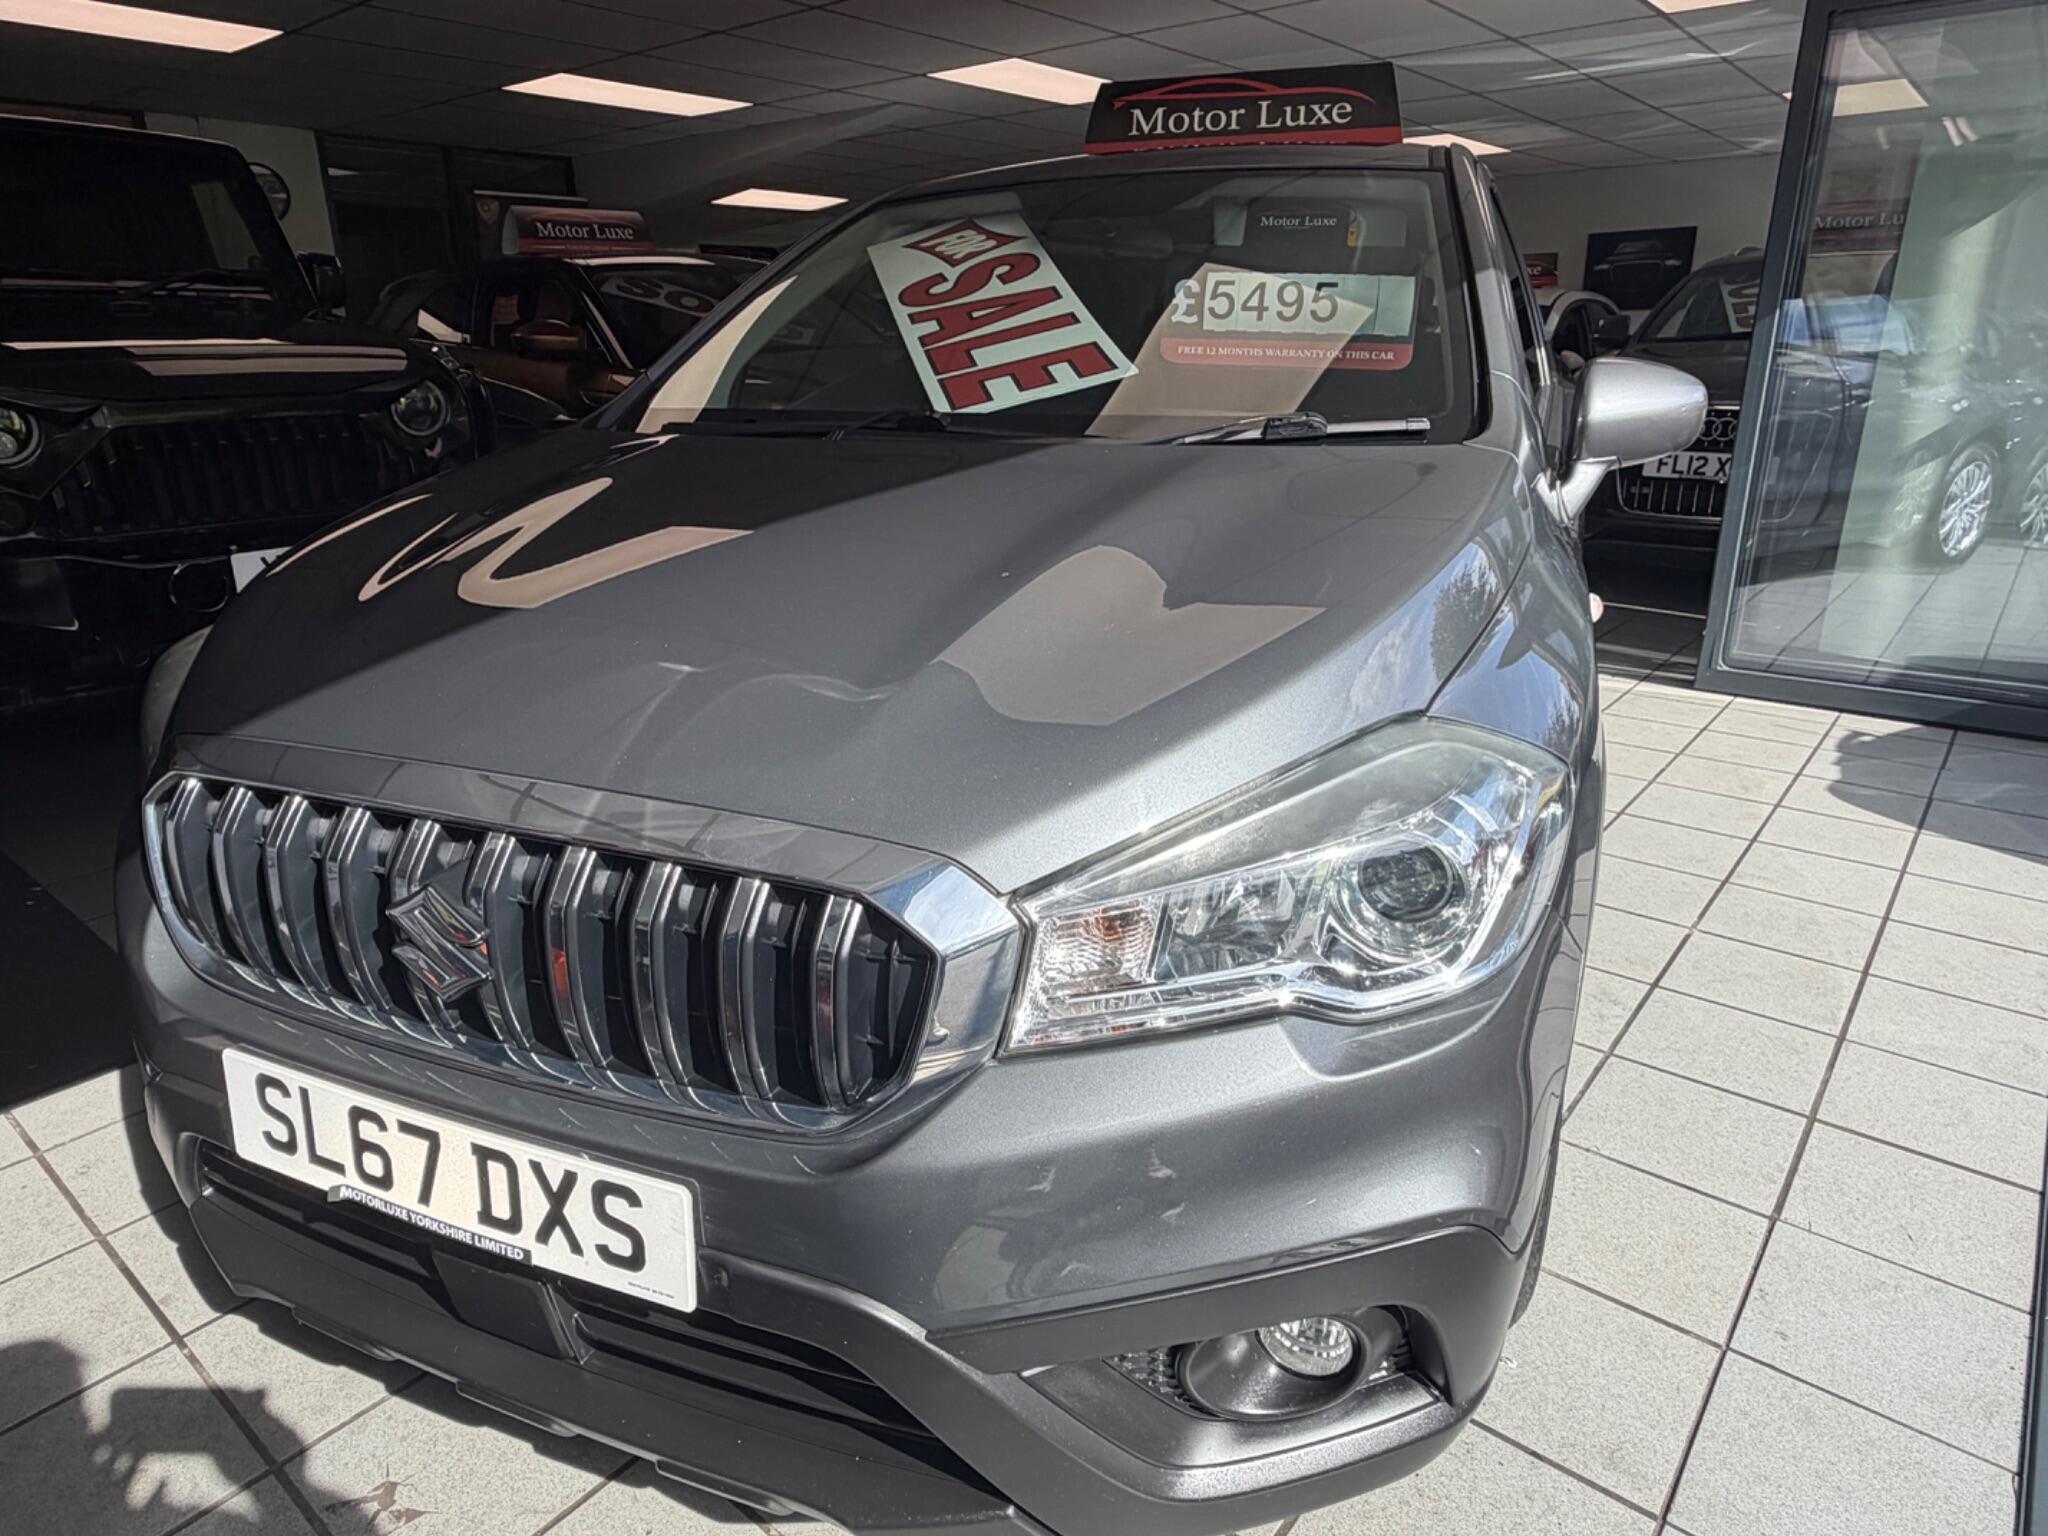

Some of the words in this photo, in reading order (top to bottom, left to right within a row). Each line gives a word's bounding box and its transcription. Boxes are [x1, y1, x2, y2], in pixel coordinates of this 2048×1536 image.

[1128, 105, 1246, 136] Motor
[1256, 100, 1353, 129] Luxe
[535, 222, 590, 239] Motor
[592, 224, 635, 239] Luxe
[1260, 215, 1300, 226] Motor
[1304, 215, 1338, 226] Luxe
[1813, 213, 1874, 230] Motor
[1879, 212, 1905, 226] Lu
[919, 229, 998, 259] FOR
[1171, 279, 1339, 324] £5495
[898, 252, 1120, 411] SALE
[1177, 346, 1204, 355] FREE
[1206, 346, 1217, 355] 12
[1218, 346, 1263, 356] MONTHS
[1265, 347, 1325, 358] WARRANTY
[1326, 349, 1344, 359] ON
[1345, 350, 1370, 360] THIS
[1371, 350, 1396, 361] CAR
[1656, 453, 1709, 476] FL12
[255, 1072, 441, 1207] SL67
[470, 1141, 646, 1273] DXS
[339, 1185, 409, 1222] MOTORLUXE
[409, 1211, 473, 1244] YORKSHIRE
[474, 1236, 524, 1261] LIMITED
